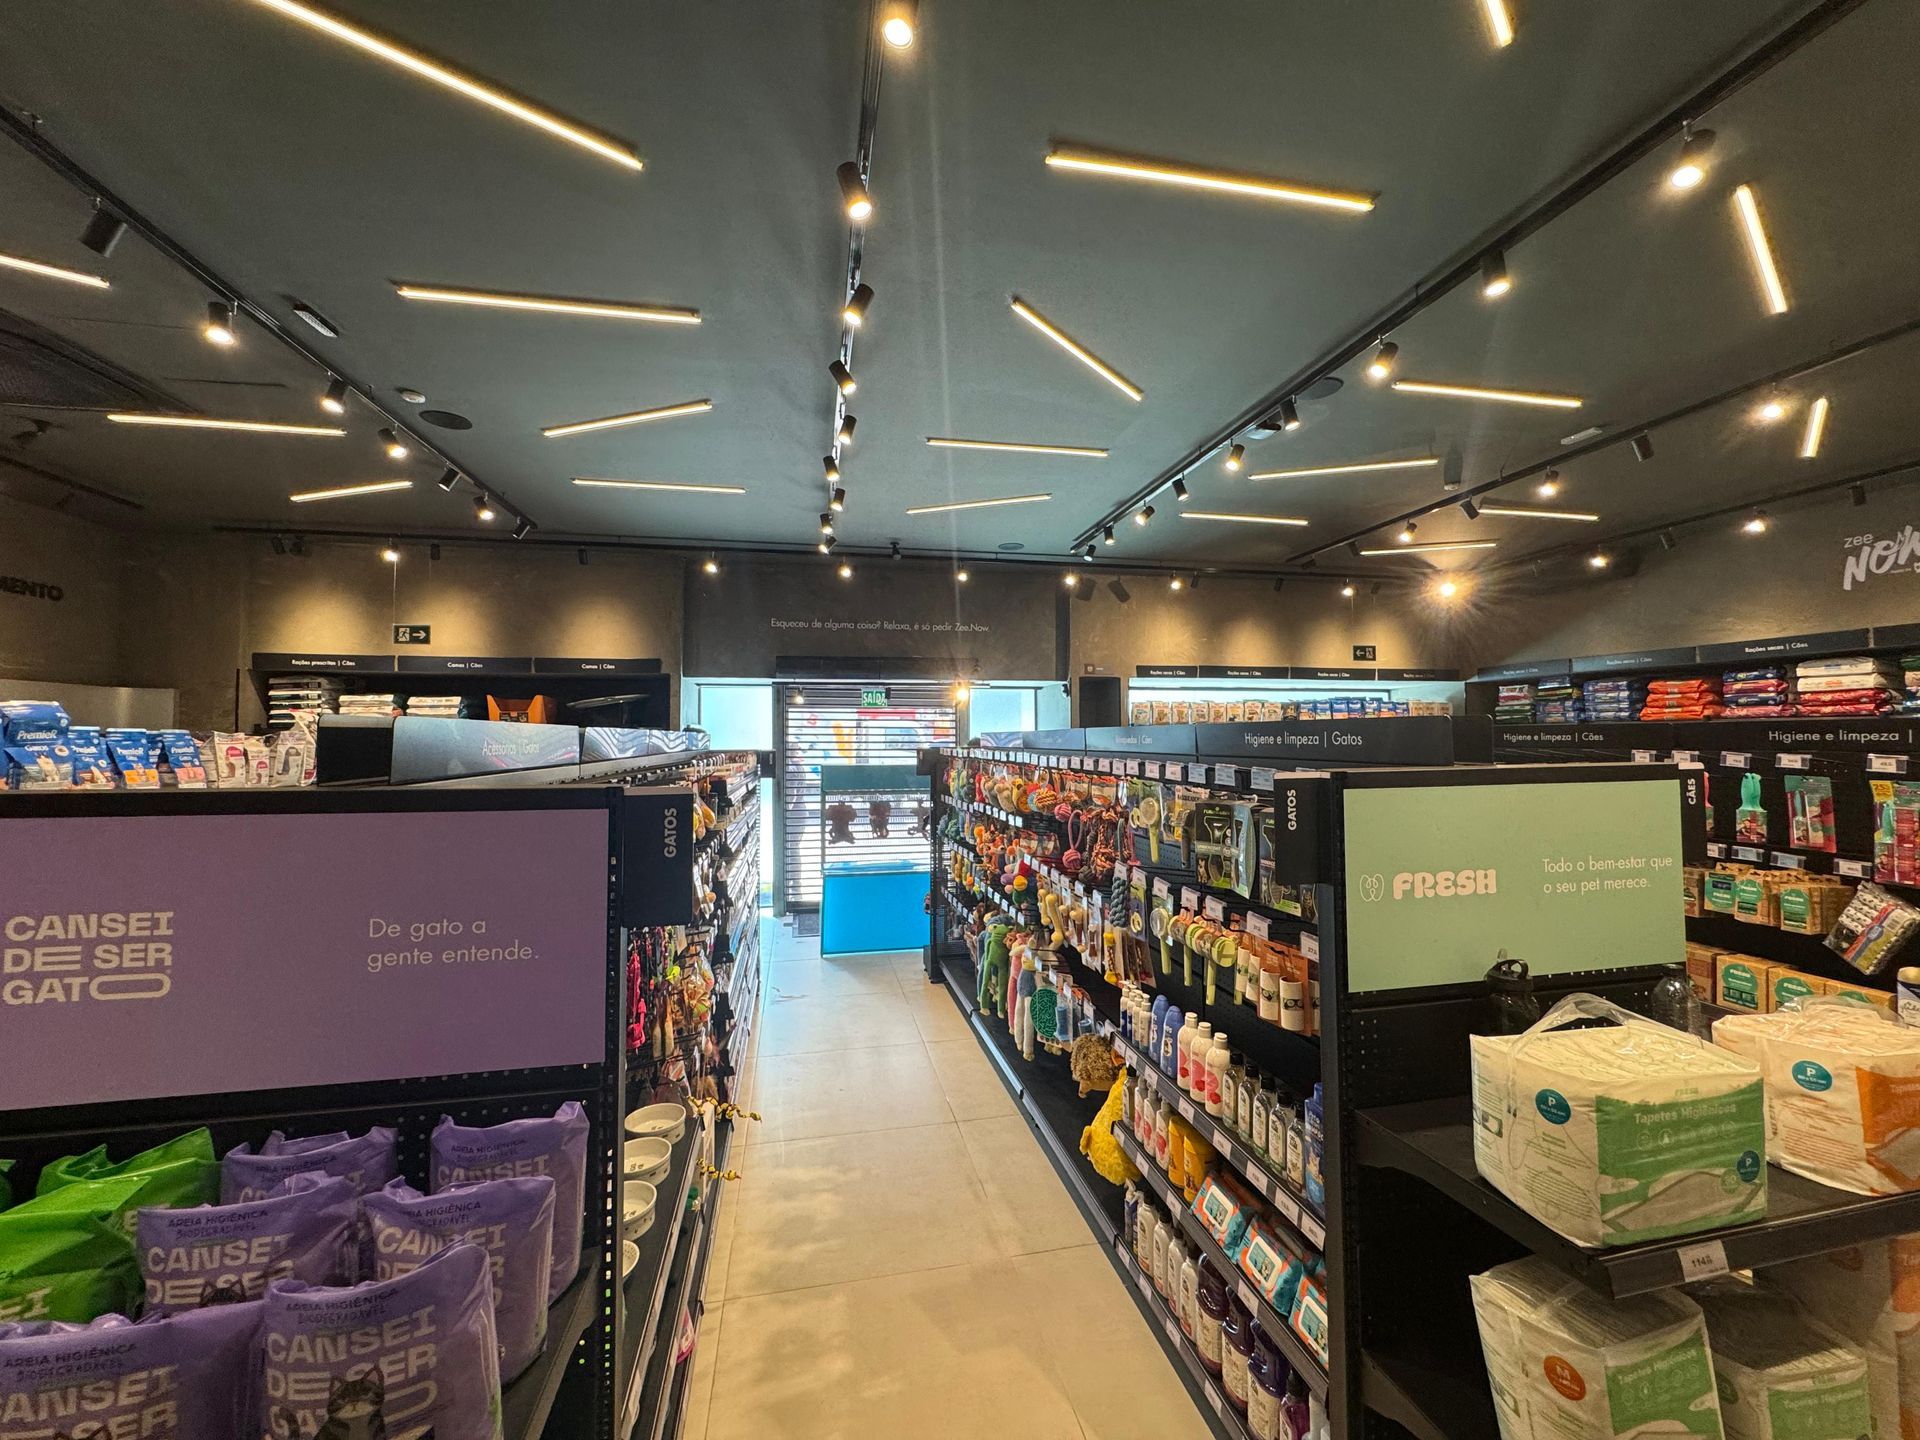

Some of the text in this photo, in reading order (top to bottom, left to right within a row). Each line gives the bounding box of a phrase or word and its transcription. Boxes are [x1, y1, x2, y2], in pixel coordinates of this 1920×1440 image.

[1844, 533, 1874, 548] zee
[771, 618, 809, 629] Esqueceu
[811, 618, 822, 628] de
[824, 619, 855, 631] alguma
[857, 620, 881, 629] coisa?
[883, 621, 912, 631] Relaxa,
[913, 621, 920, 630] é
[921, 622, 930, 630] só
[932, 622, 952, 633] pedir
[863, 689, 886, 704] SAÍDA
[1244, 731, 1275, 748] Higiene
[1276, 735, 1282, 745] e
[1284, 731, 1319, 748] limpeza
[1331, 731, 1363, 745] Gatos
[1503, 733, 1532, 743] Higiene
[1540, 732, 1572, 743] limpeza
[1581, 732, 1603, 741] Cães
[1768, 731, 1821, 744] Higiene
[1825, 733, 1834, 741] e
[1839, 729, 1899, 744] limpeza
[1686, 778, 1696, 805] CÃES
[1287, 789, 1297, 830] GATOS
[664, 807, 677, 858] GATOS
[1542, 856, 1673, 873] Todo o bem-estar que
[1392, 868, 1497, 900] FRESH
[1543, 877, 1651, 896] o seu pet merece.
[4, 911, 174, 942] CANSEI
[369, 918, 487, 942] De gato a
[3, 942, 173, 974] DE SER
[367, 939, 540, 973] gente entende.
[2, 972, 171, 1005] GATO
[1634, 1111, 1678, 1125] Tapetes
[206, 1209, 269, 1225] HIGIÊNICA
[425, 1201, 482, 1217] HIGIÊNICA
[266, 1304, 437, 1364] CANSEI
[55, 1342, 138, 1364] HIGIÊNICA
[266, 1367, 331, 1401] DE
